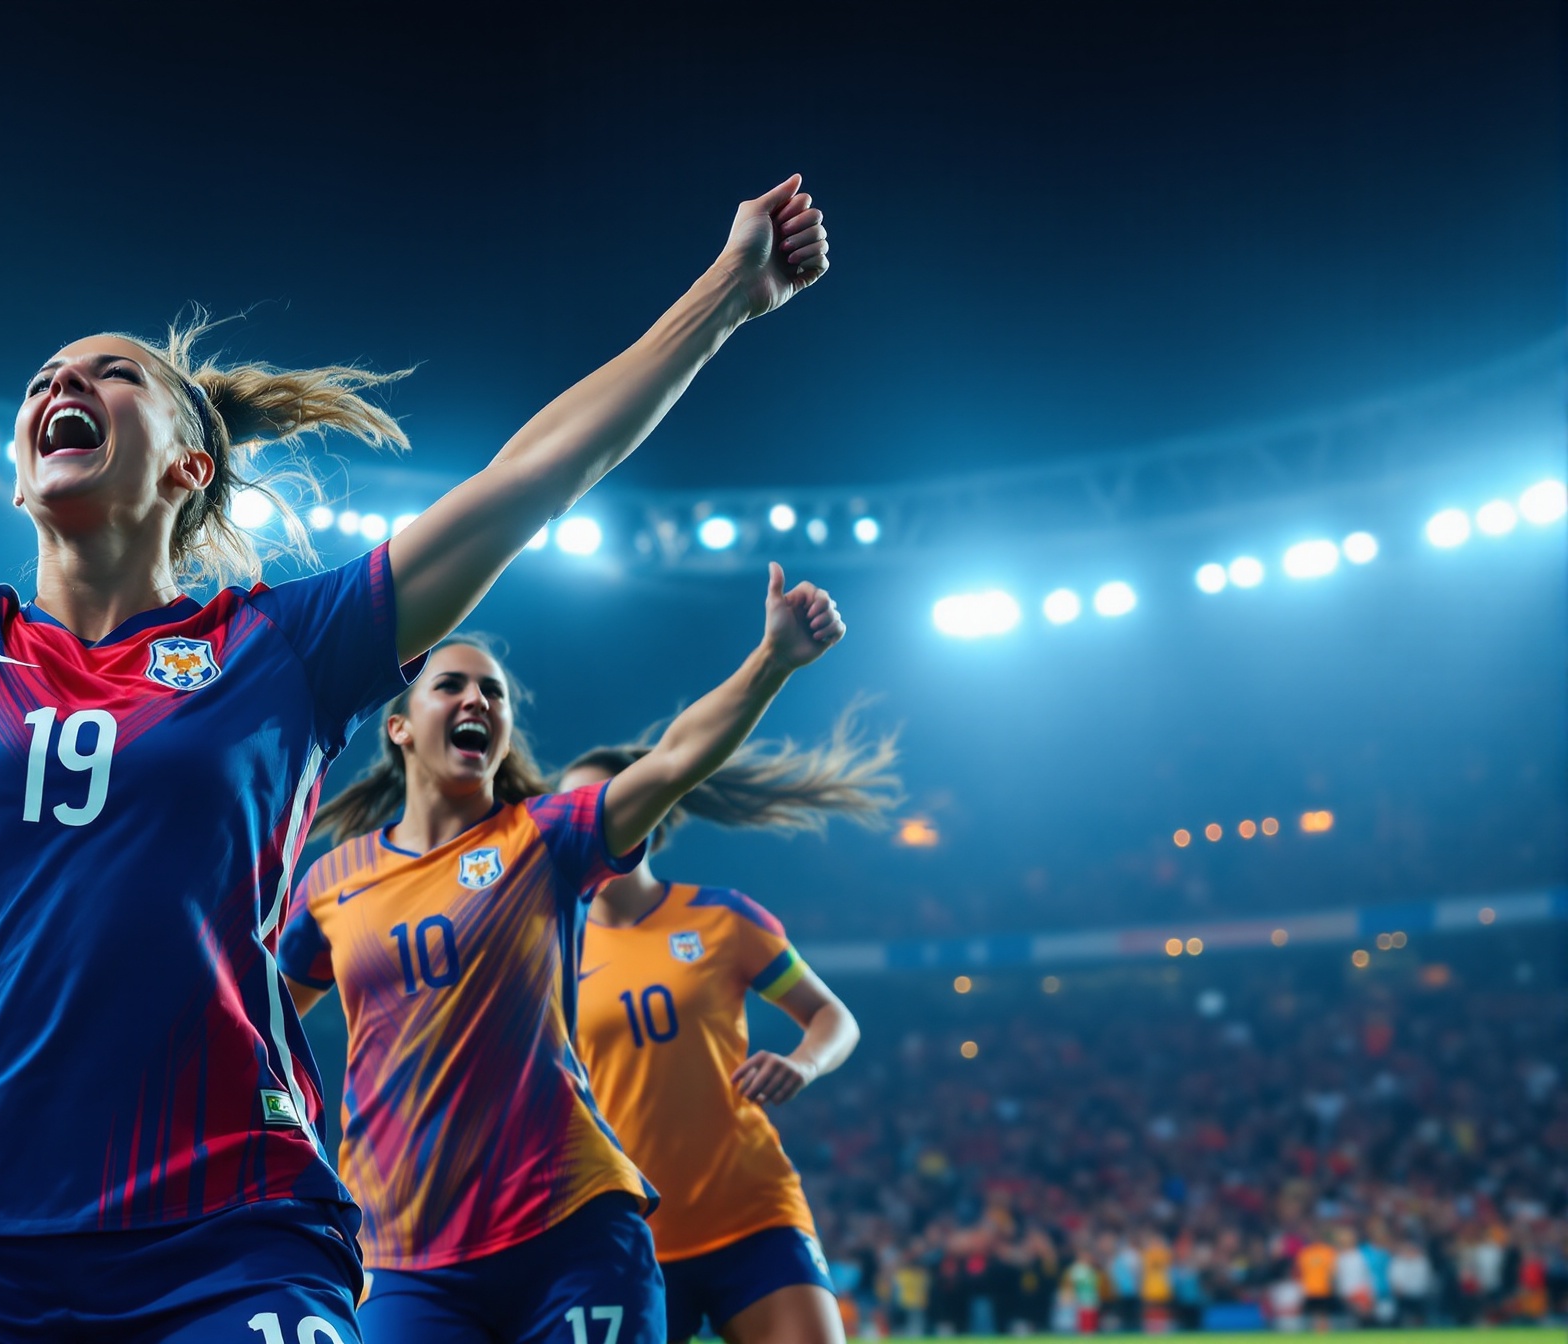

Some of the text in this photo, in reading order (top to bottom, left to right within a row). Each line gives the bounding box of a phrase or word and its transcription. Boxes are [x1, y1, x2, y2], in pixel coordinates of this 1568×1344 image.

[23, 706, 118, 827] 19
[390, 913, 461, 996] 10
[619, 984, 680, 1049] 10
[564, 1305, 623, 1344] 17
